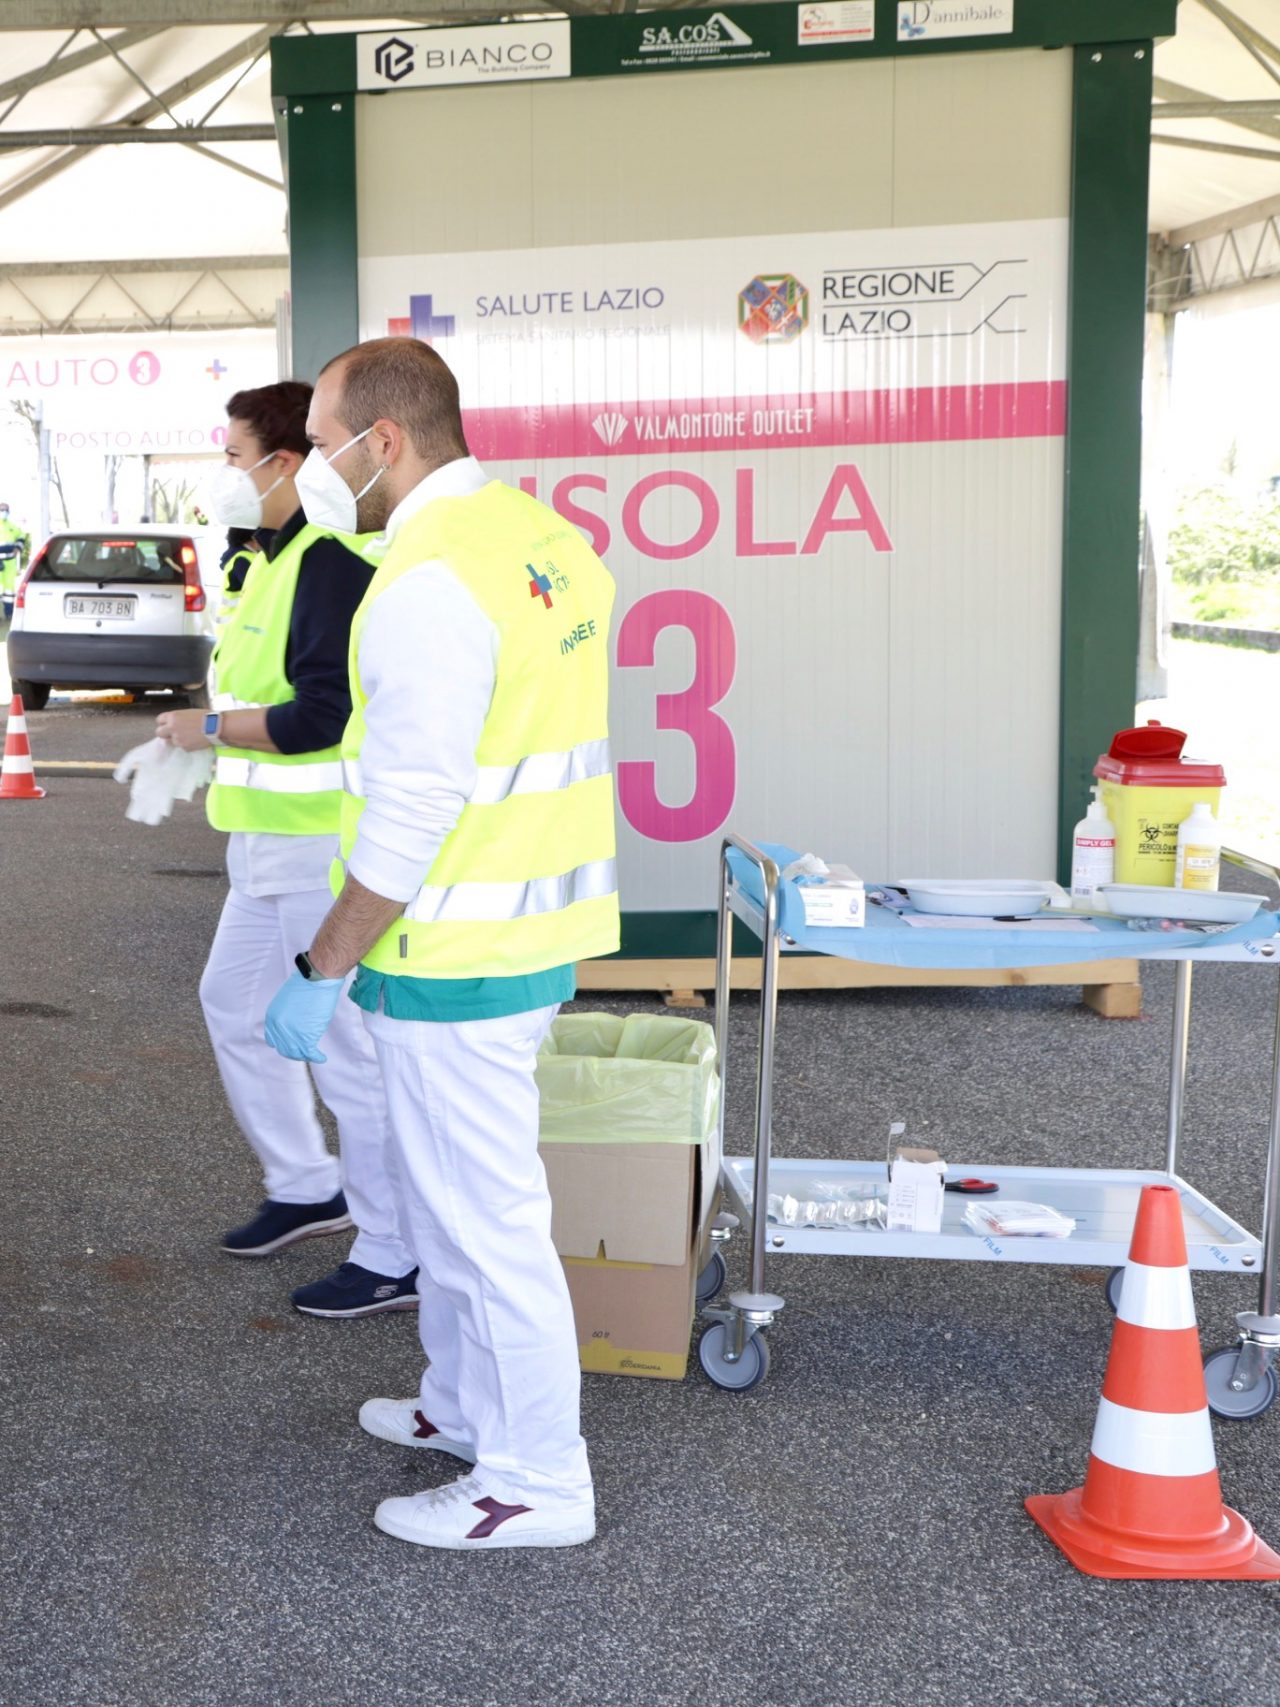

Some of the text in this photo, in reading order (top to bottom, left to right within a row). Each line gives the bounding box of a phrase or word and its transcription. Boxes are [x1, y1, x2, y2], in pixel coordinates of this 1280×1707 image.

[642, 24, 720, 45] SA.COS
[426, 43, 553, 69] BIANCO
[823, 270, 955, 300] REGIONE
[476, 287, 665, 318] SALUTE LAZIO
[823, 309, 912, 336] LAZIO
[6, 357, 120, 389] AUTO
[56, 431, 132, 449] POSTO
[140, 429, 205, 447] AUTO
[634, 407, 815, 441] VALMONTONE OUTLET
[521, 463, 895, 560] SOLA
[70, 601, 132, 615] BA 703 BN
[616, 588, 738, 845] 3
